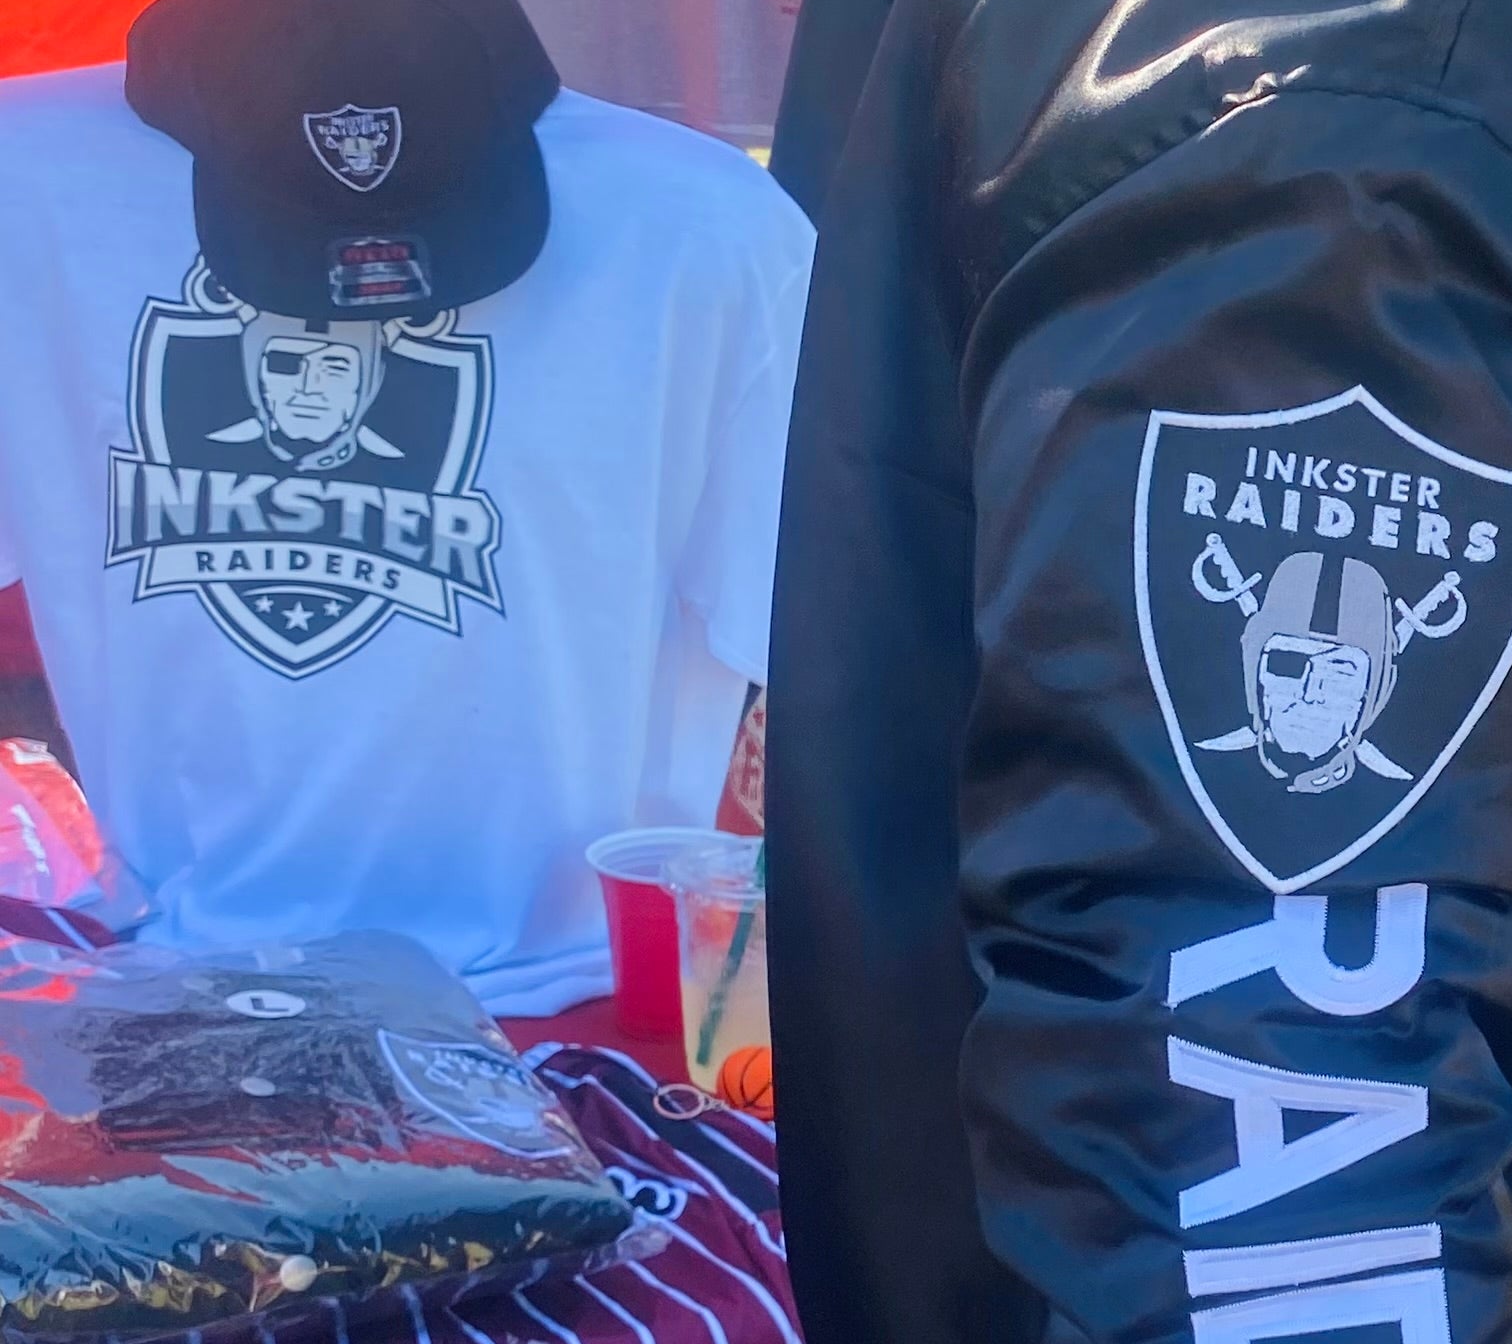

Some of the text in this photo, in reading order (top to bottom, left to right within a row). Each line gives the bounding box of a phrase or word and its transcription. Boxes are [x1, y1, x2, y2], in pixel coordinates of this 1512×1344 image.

[1246, 446, 1442, 509] INKSTER
[114, 460, 494, 589] INKSTER
[1183, 472, 1500, 563] RAIDERS
[195, 549, 402, 591] RAIDERS
